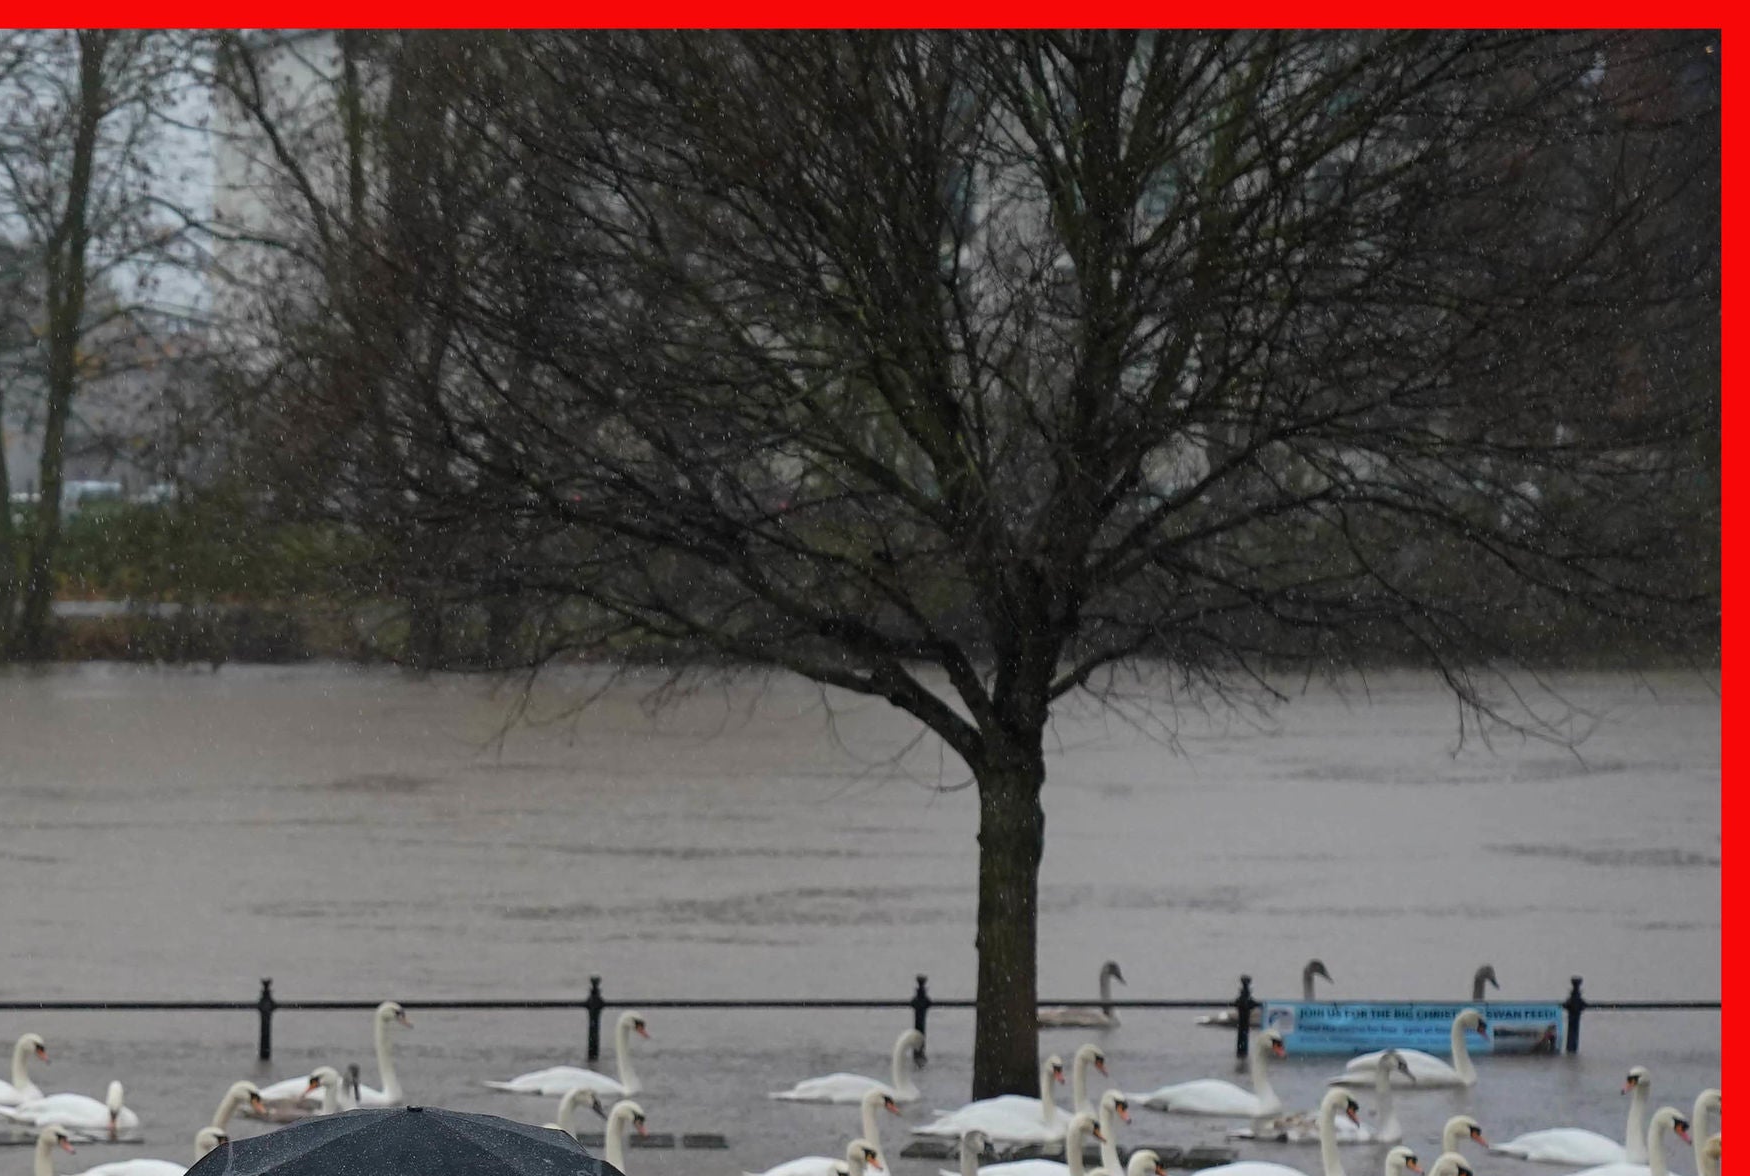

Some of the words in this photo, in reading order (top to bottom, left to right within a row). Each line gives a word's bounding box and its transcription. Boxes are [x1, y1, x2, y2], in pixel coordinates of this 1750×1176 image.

[1299, 1008, 1325, 1019] JOIN
[1344, 1009, 1368, 1019] FOR
[1370, 1009, 1391, 1019] THE
[1394, 1009, 1413, 1020] BIG
[1486, 1010, 1522, 1020] SWAN
